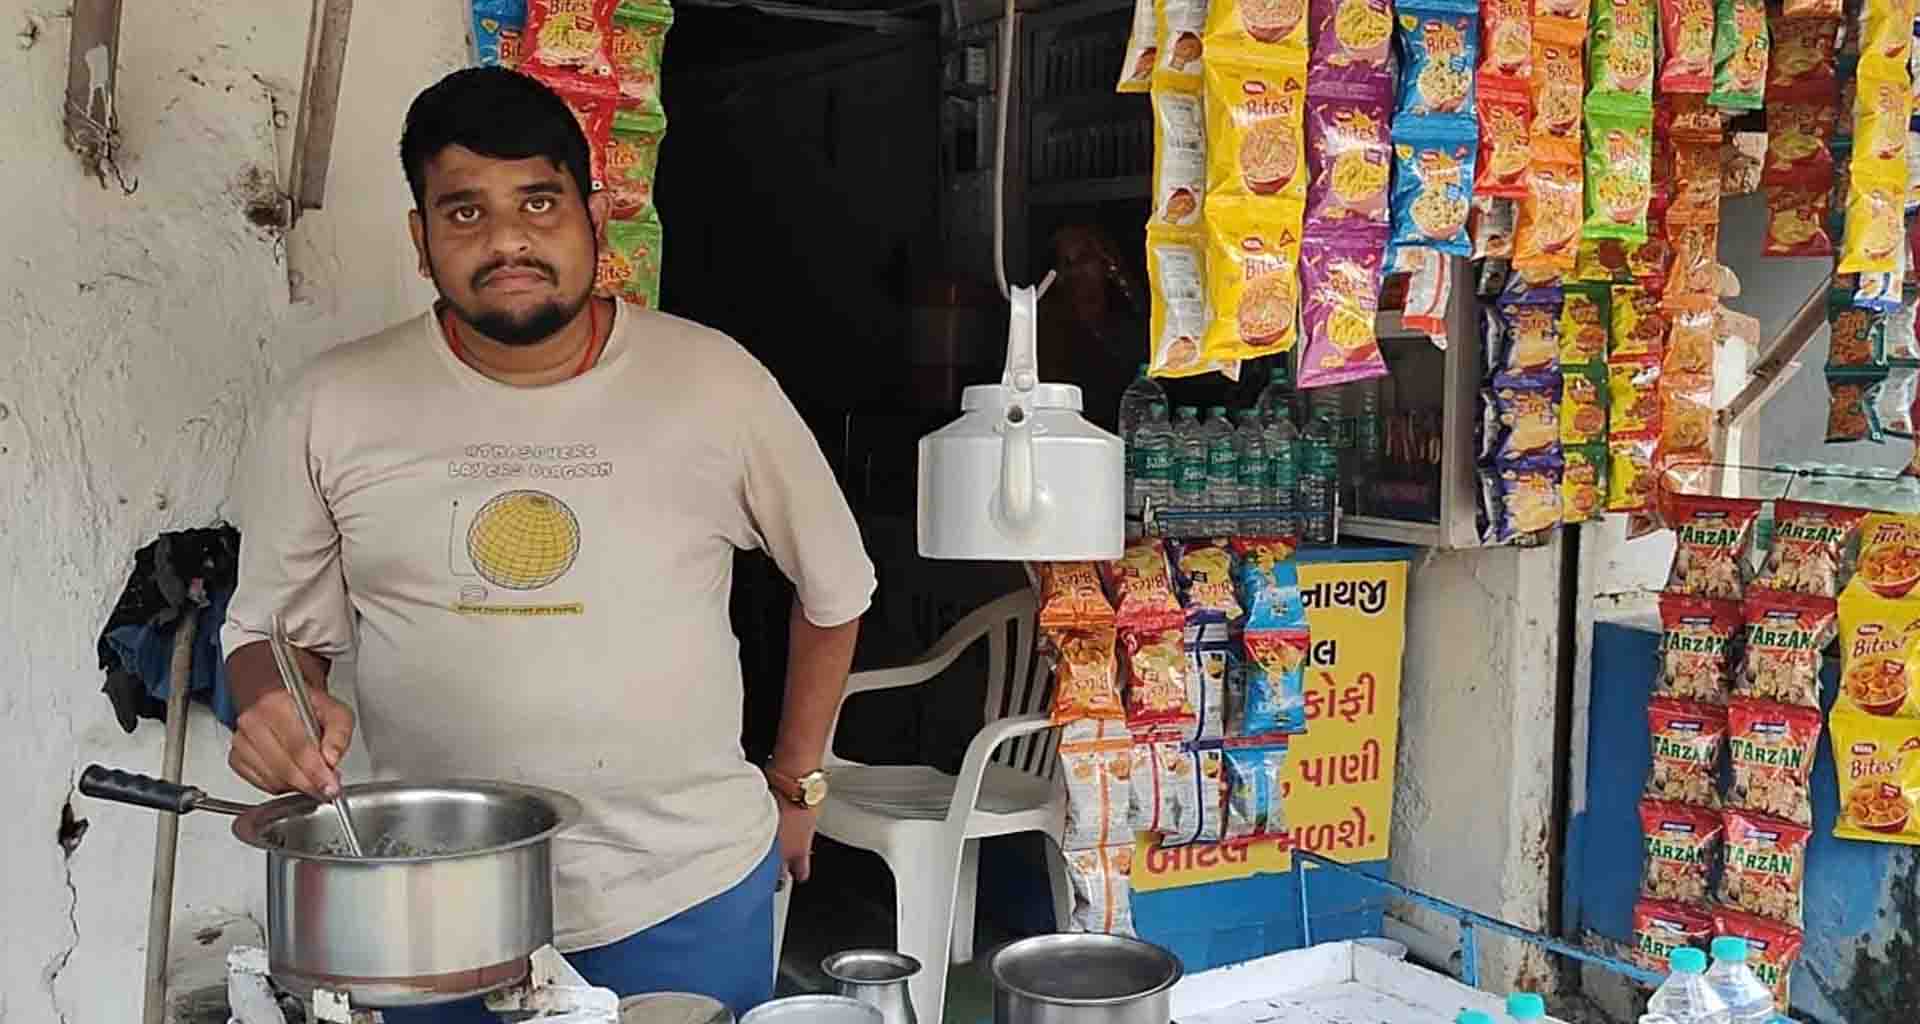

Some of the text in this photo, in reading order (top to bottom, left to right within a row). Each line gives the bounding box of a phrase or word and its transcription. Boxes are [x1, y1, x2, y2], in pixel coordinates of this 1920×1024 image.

[501, 41, 521, 58] Bit
[1678, 526, 1741, 545] TARZAN
[1775, 521, 1841, 543] TARZAN
[1662, 631, 1729, 654] TARZAN
[1748, 626, 1816, 649] TARZAN
[1651, 736, 1714, 760] TARZAN
[1730, 739, 1803, 768] TARZAN
[1646, 836, 1706, 864] TARZAN
[1725, 843, 1793, 874] TARZAN
[1636, 932, 1673, 957] TARZ
